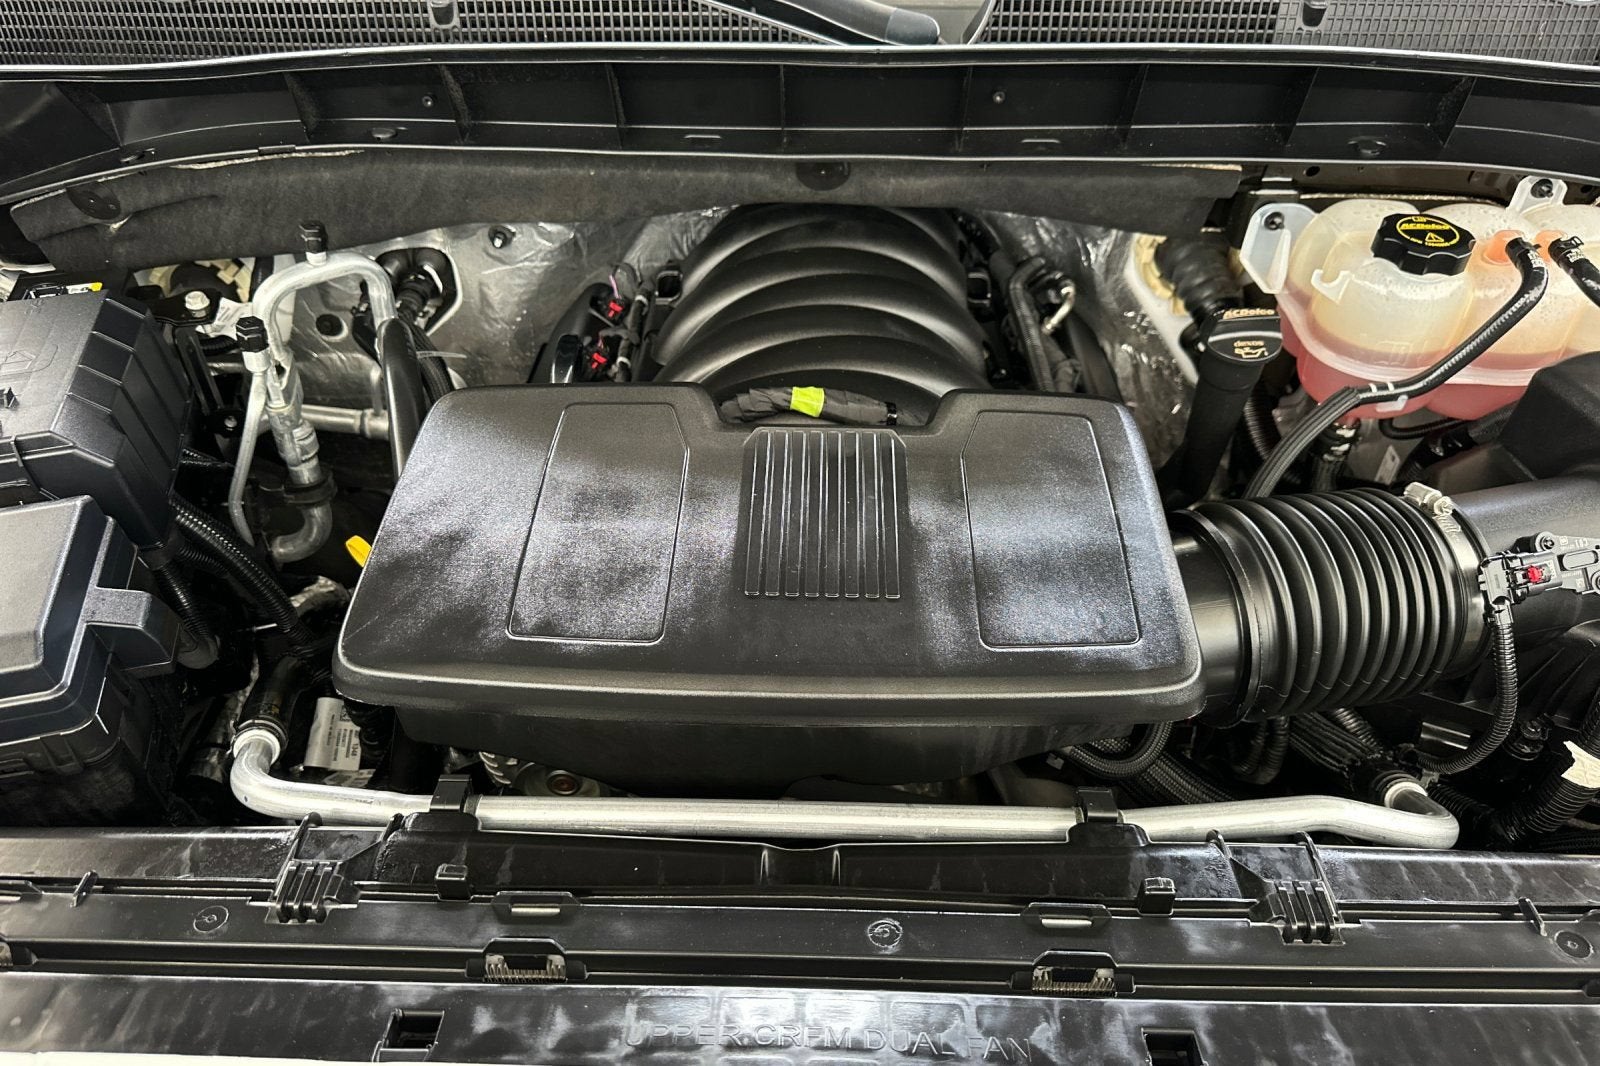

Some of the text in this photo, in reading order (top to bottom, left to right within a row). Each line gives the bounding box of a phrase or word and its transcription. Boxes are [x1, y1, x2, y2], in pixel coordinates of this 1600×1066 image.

[1223, 308, 1275, 320] ACDelco
[626, 1023, 742, 1047] UPPER
[864, 1029, 955, 1055] DUAL
[967, 1036, 1032, 1062] FAN
